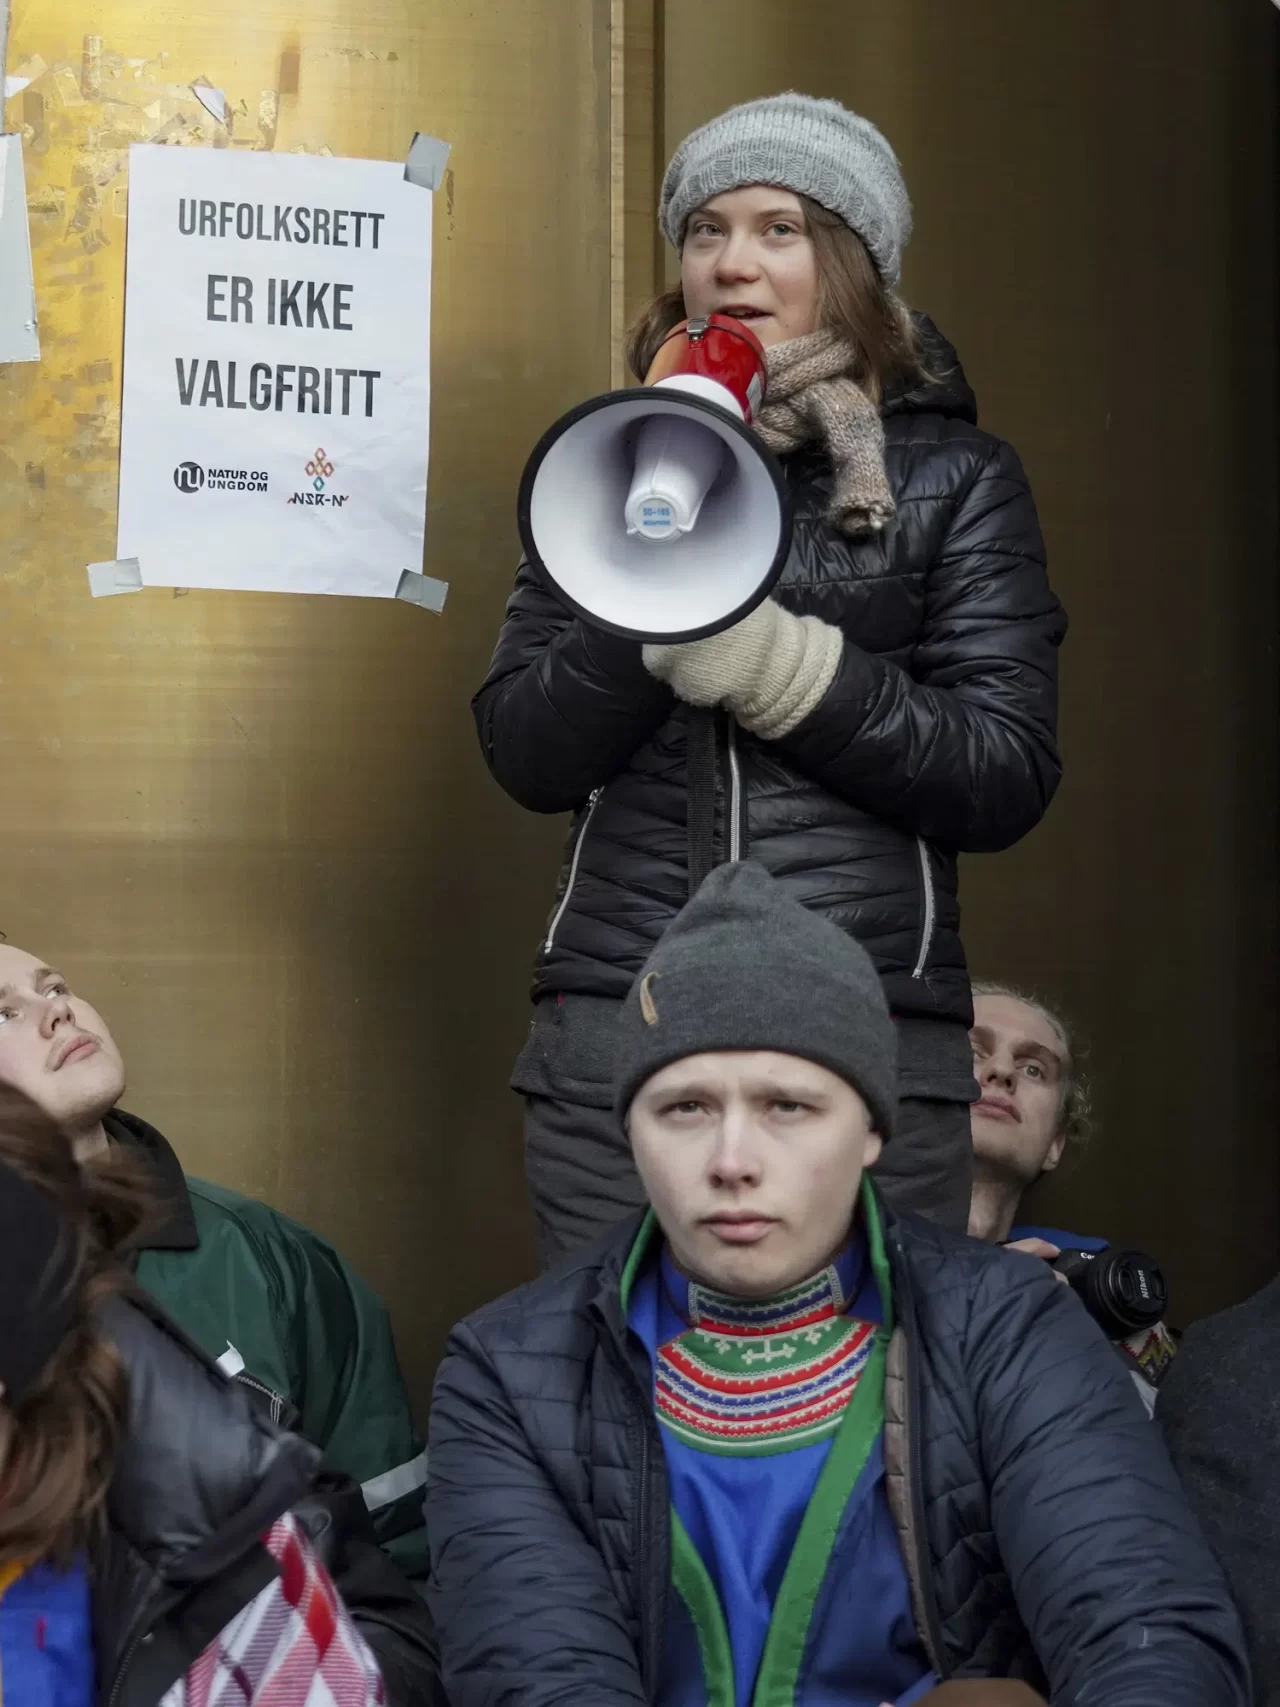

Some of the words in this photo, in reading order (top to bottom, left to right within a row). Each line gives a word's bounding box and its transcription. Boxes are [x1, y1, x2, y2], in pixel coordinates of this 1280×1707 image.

[177, 198, 385, 249] URFOLKSRETT
[206, 274, 253, 324] ER
[267, 278, 354, 331] IKKE
[174, 357, 381, 417] VALGFRITT
[207, 480, 268, 492] UNGDOM
[208, 469, 247, 480] NATUR
[250, 471, 268, 481] OG
[1137, 1269, 1150, 1299] Nikon
